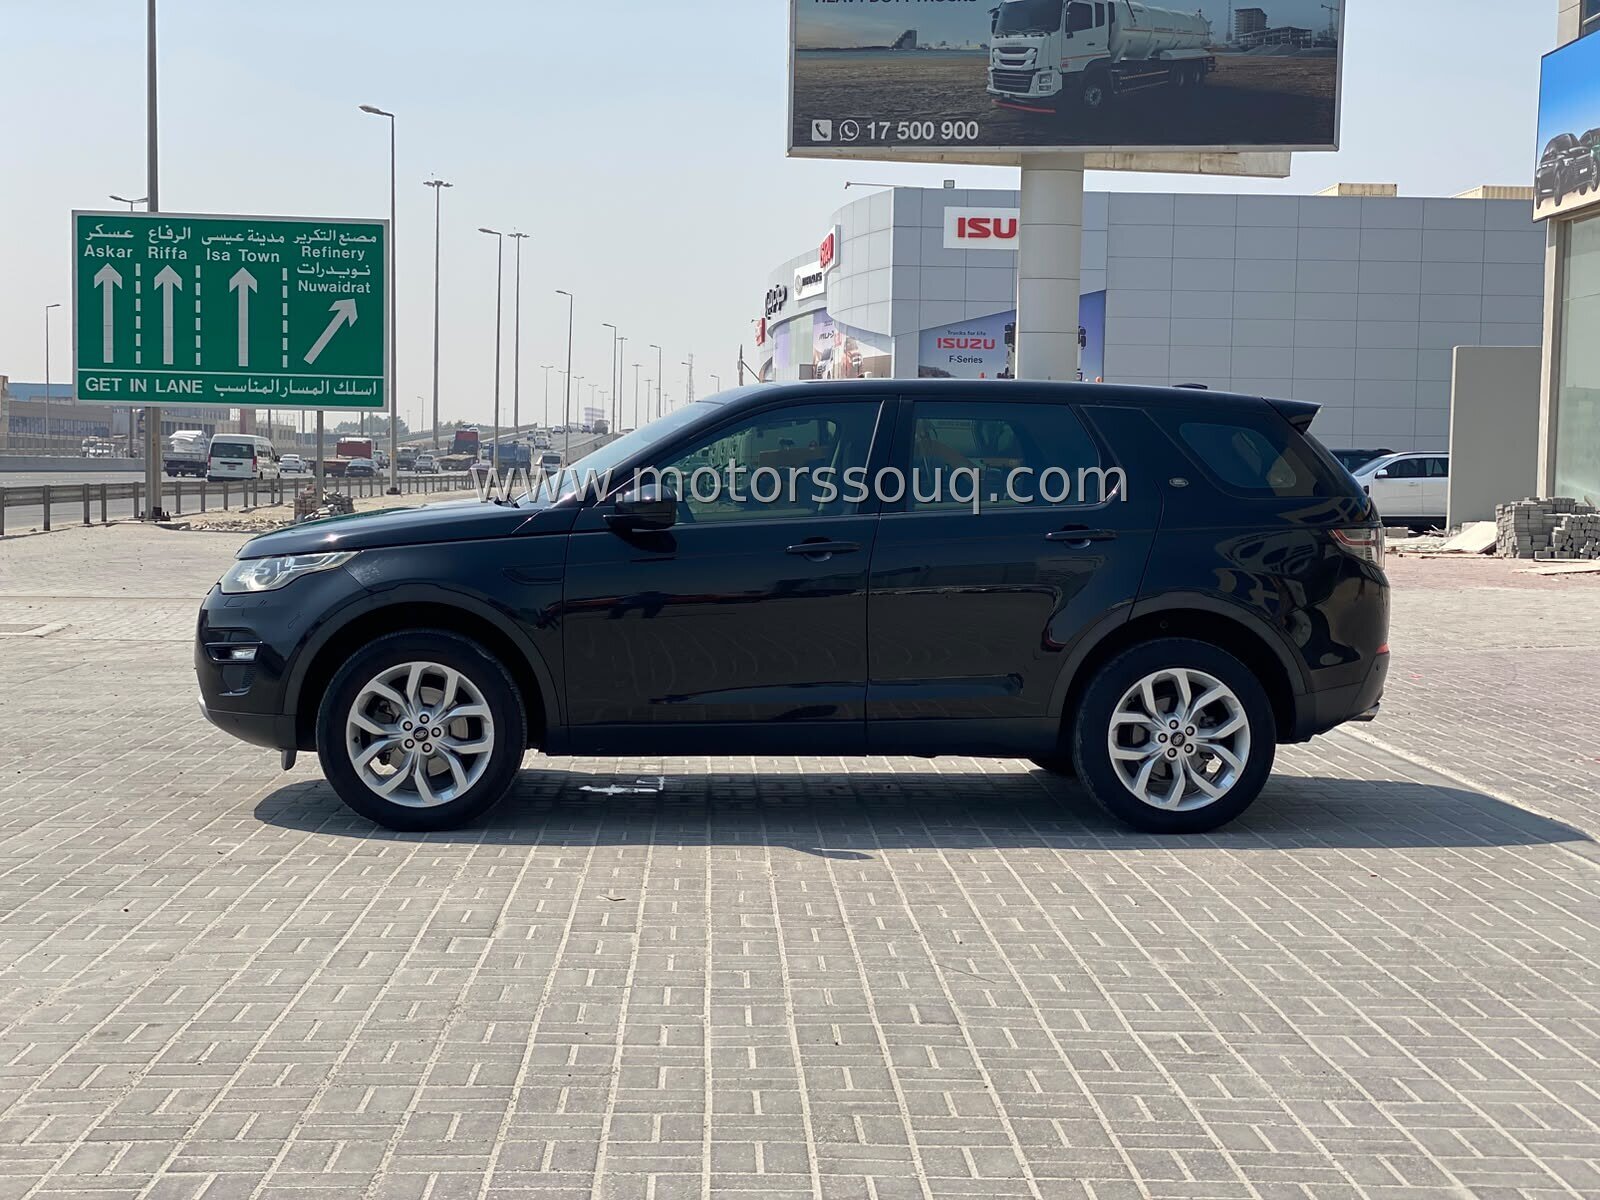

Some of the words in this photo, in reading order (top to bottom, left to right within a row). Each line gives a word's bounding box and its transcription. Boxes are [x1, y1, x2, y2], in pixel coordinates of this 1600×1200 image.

[866, 121, 891, 140] 17
[896, 121, 935, 140] 500
[940, 121, 979, 140] 900
[84, 224, 135, 241] عسكر
[148, 224, 192, 244] الرفاع
[201, 231, 245, 246] عيسى
[247, 229, 285, 247] مدينة
[293, 229, 336, 245] التكرير
[338, 231, 377, 246] مصنع
[84, 244, 133, 259] Askar
[147, 246, 188, 260] Riffa
[206, 248, 231, 261] Isa
[238, 249, 280, 263] Town
[301, 245, 365, 261] Refinery
[296, 262, 371, 279] نويدرات
[298, 280, 371, 294] Nuwaidrat
[938, 338, 995, 350] ISUZU
[949, 356, 983, 364] F-Series
[85, 378, 122, 392] GET
[130, 379, 147, 393] IN
[155, 379, 203, 395] LANE
[214, 378, 279, 397] المناسب
[279, 379, 329, 398] المسار
[333, 381, 377, 396] اسلك
